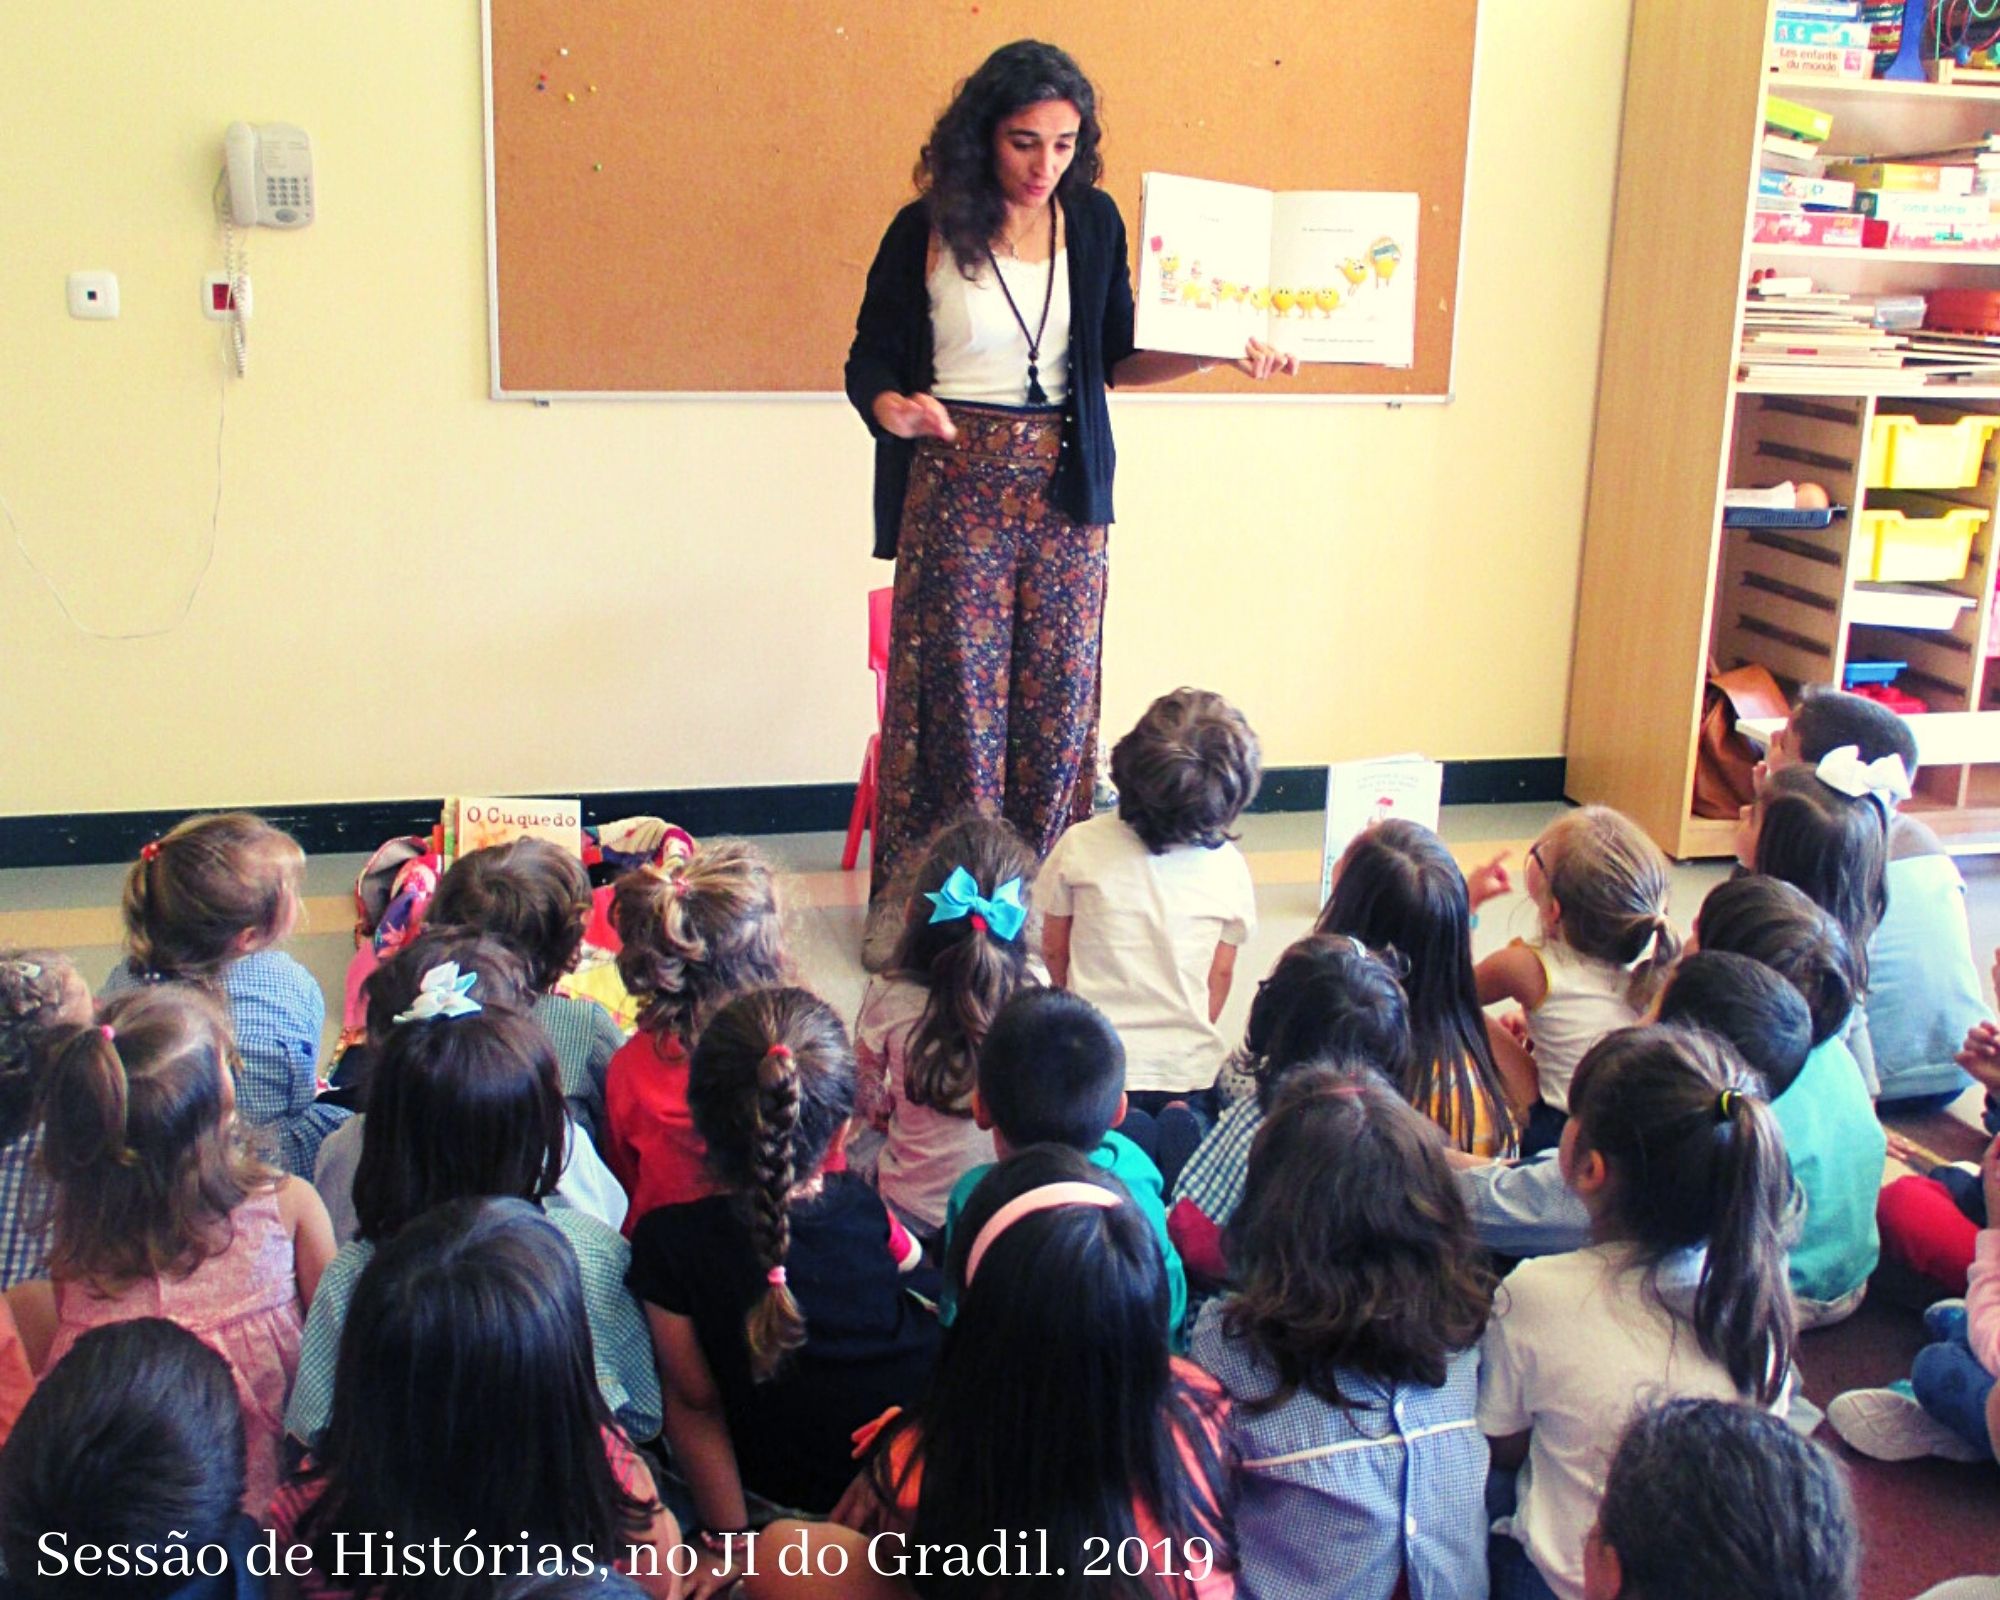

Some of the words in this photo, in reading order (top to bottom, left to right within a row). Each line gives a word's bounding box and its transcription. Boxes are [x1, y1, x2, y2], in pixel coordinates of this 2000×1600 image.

[1779, 47, 1798, 58] Les
[1800, 49, 1838, 61] enfants
[1786, 60, 1800, 70] du
[1802, 62, 1836, 71] monde
[466, 806, 482, 823] O
[487, 807, 577, 829] Cuquedo
